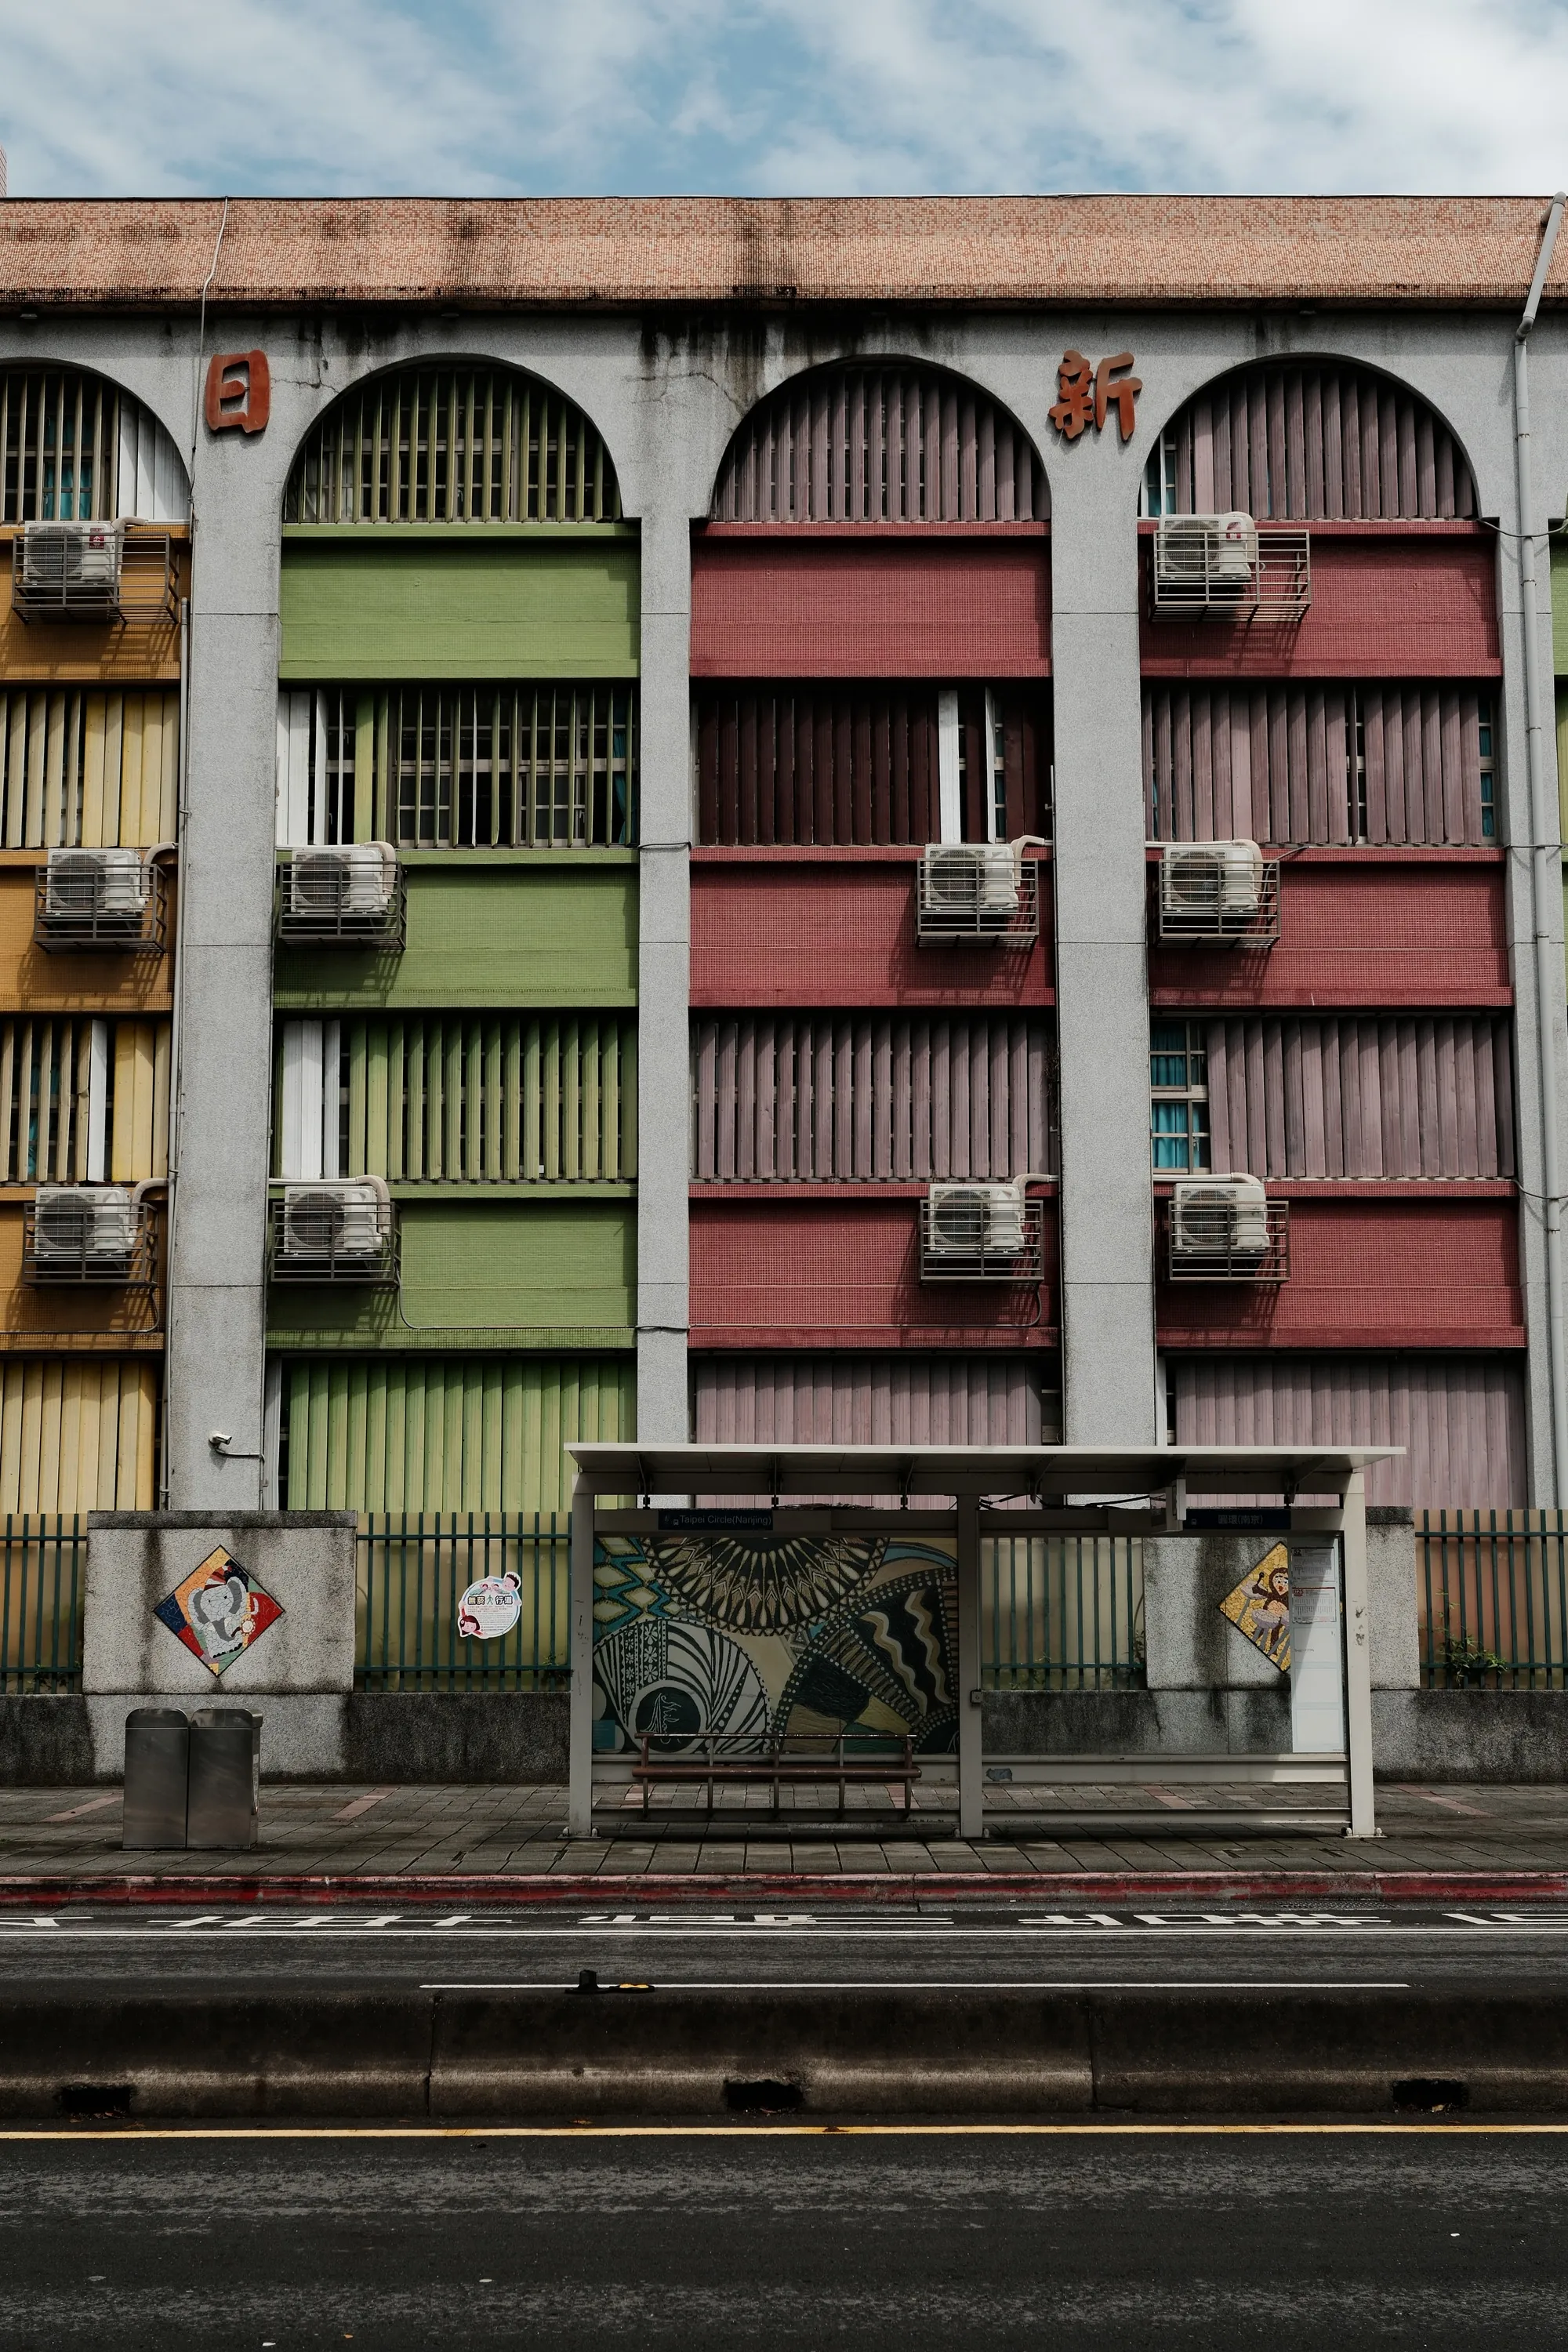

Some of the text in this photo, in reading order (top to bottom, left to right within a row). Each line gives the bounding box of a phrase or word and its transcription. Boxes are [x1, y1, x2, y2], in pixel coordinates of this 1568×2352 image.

[205, 349, 1142, 441] 日 新
[680, 1515, 772, 1525] Taipei Circle(Nanjing)
